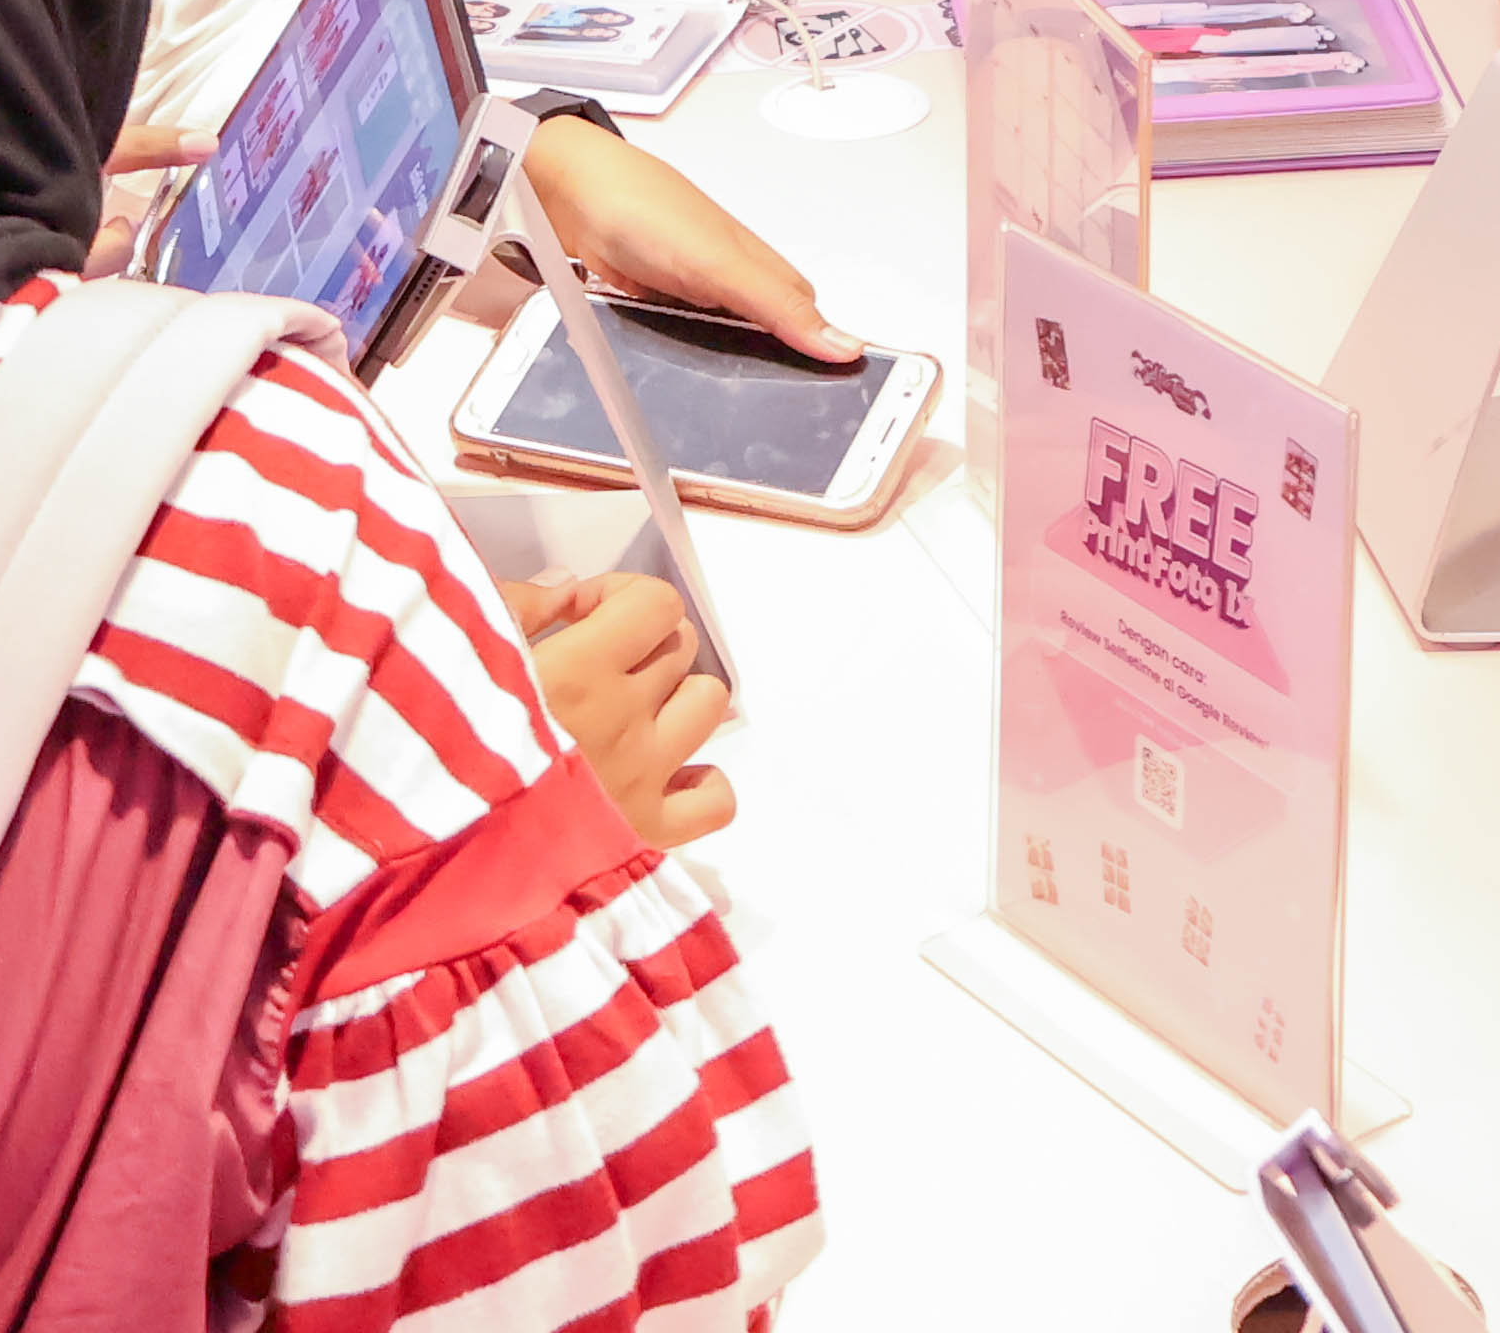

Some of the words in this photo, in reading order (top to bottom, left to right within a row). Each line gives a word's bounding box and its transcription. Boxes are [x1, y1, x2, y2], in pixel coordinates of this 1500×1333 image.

[1085, 417, 1260, 582] FREE
[1151, 544, 1219, 610] Foto
[1118, 618, 1170, 662] Dengan
